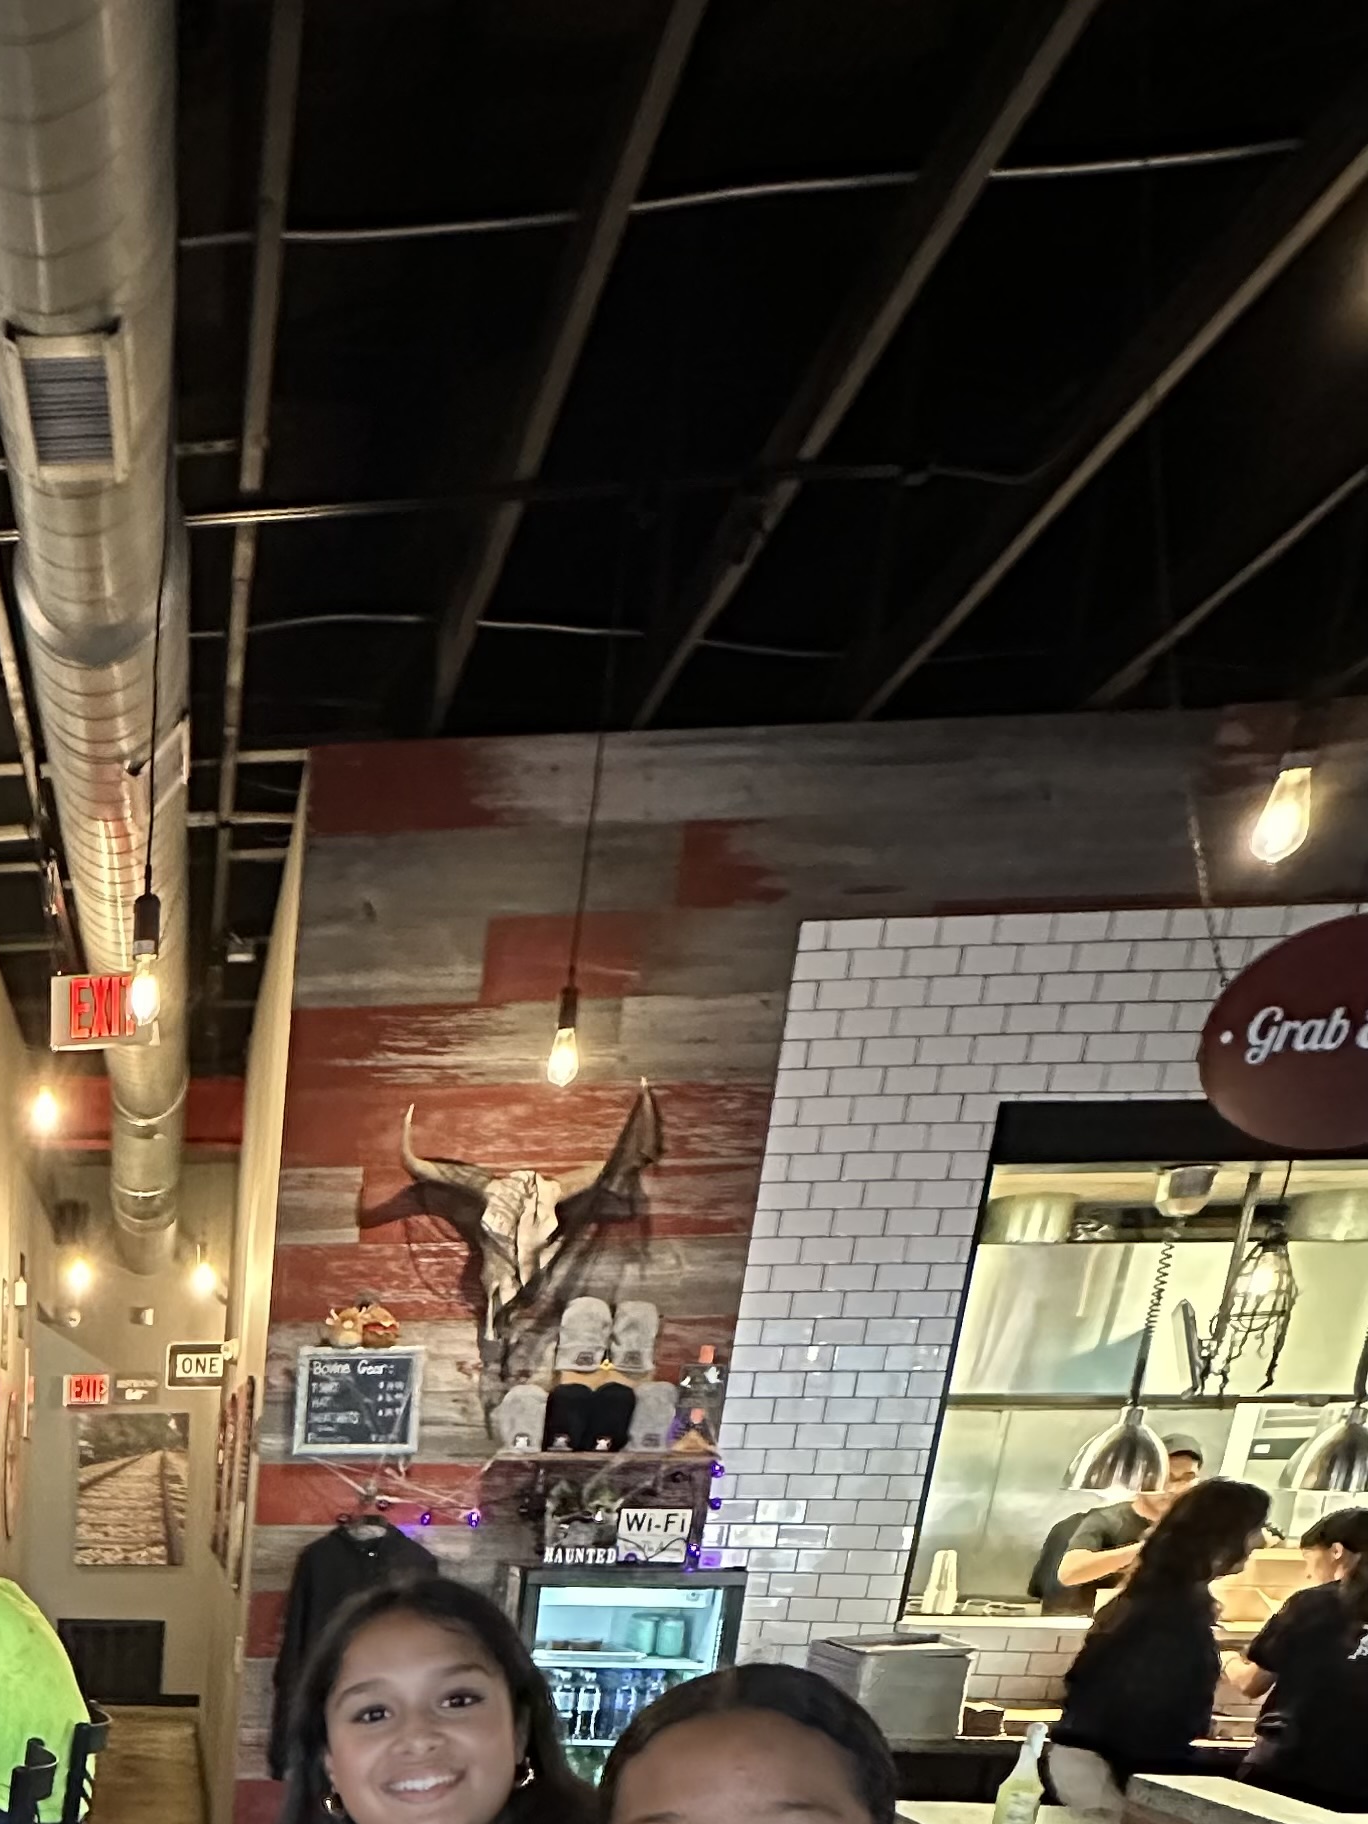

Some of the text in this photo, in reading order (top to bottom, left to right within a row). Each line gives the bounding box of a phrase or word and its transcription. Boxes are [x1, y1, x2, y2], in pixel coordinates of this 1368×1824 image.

[1244, 1006, 1351, 1065] Grab
[182, 1357, 220, 1374] ONE
[626, 1513, 685, 1532] Wi-Fi
[543, 1547, 616, 1563] HAUNTED
